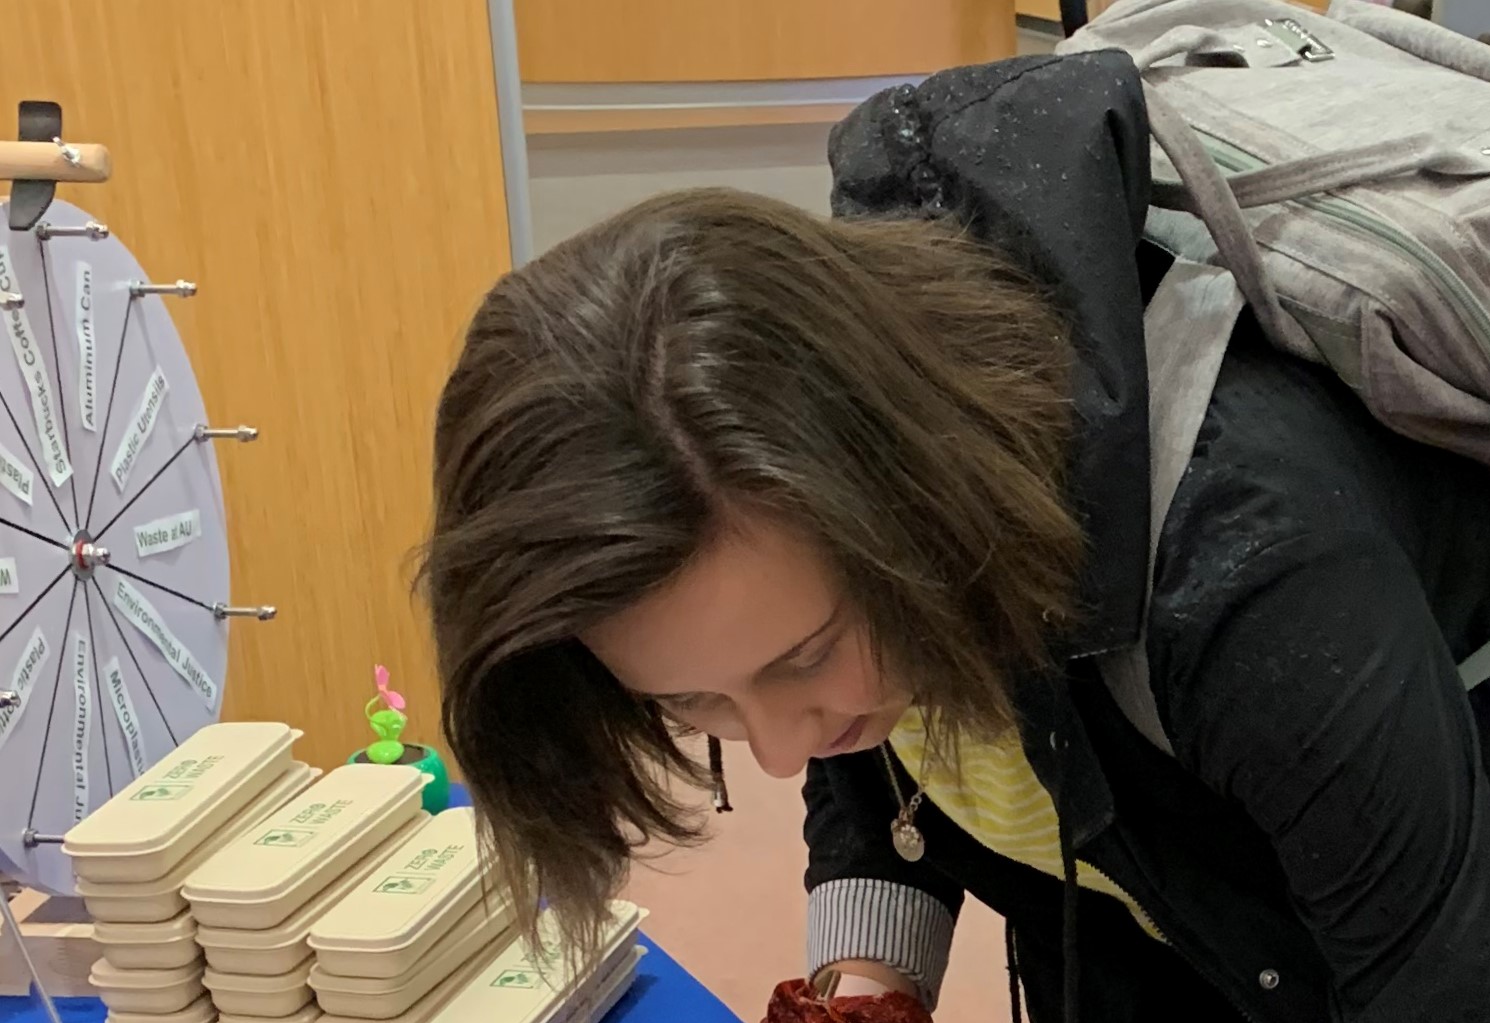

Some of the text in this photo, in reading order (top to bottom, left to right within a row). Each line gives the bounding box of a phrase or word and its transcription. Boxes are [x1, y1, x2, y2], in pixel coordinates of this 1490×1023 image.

[10, 308, 36, 366] Coffe
[81, 270, 94, 426] Aluminum Can
[34, 370, 67, 474] Starbucks
[115, 373, 166, 485] Plastic Utensils
[137, 527, 168, 548] Waste
[179, 520, 192, 537] AU
[17, 636, 46, 691] Plastic
[117, 581, 212, 698] Environmental Justice
[75, 639, 87, 790] Environmental
